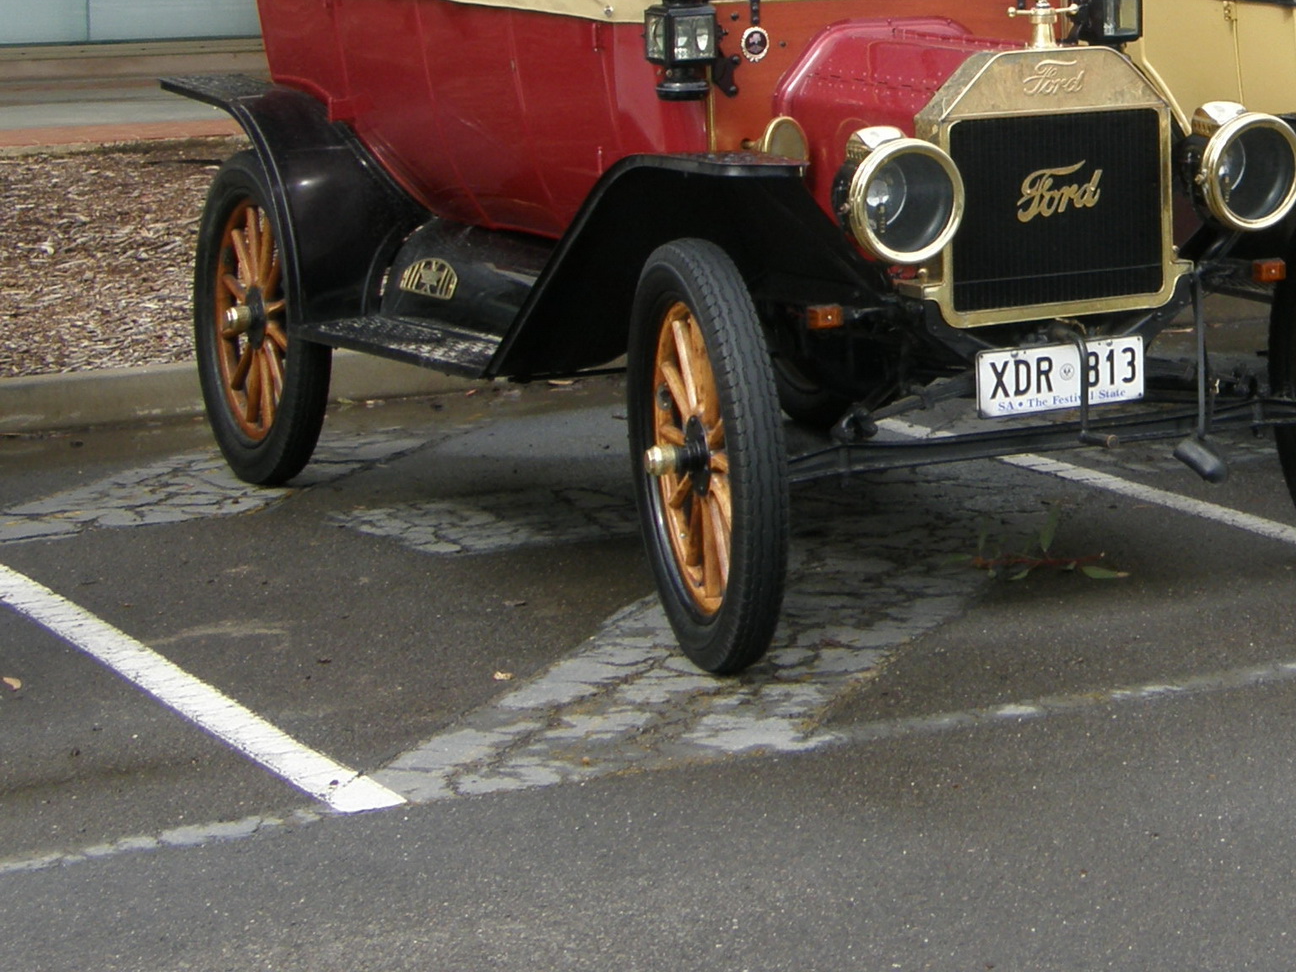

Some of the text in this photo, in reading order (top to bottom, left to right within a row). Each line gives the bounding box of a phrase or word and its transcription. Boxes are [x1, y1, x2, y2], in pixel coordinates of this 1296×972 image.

[1023, 59, 1085, 95] Ford
[1017, 159, 1103, 222] Ford
[989, 347, 1136, 400] XDR 813
[998, 388, 1126, 411] SA The Festivl State
